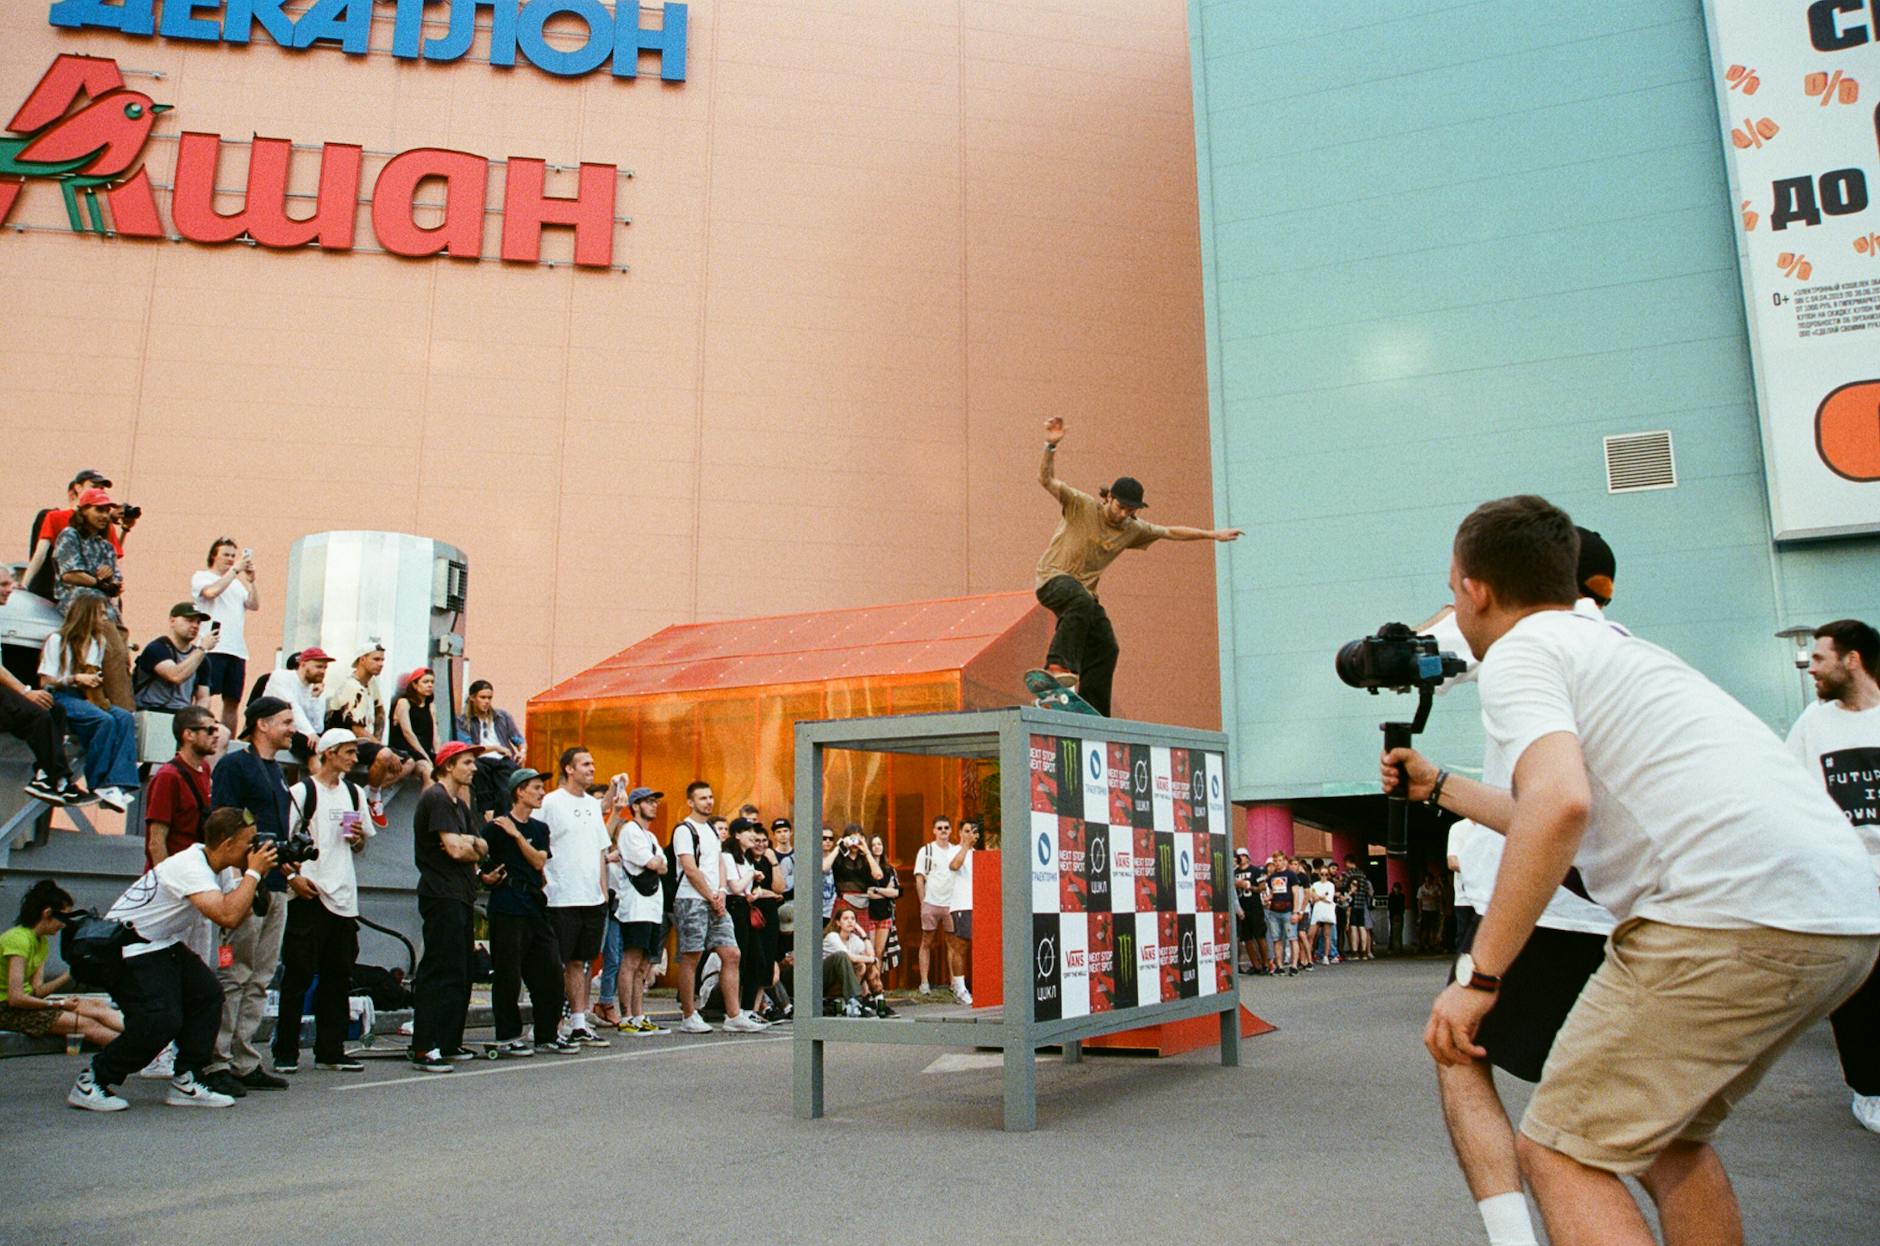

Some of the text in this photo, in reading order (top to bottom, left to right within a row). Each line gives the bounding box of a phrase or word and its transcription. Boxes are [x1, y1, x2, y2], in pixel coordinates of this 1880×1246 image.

[1807, 0, 1880, 52] С
[1771, 167, 1869, 231] ДО
[1772, 292, 1790, 306] 0+
[1066, 950, 1085, 968] VANS
